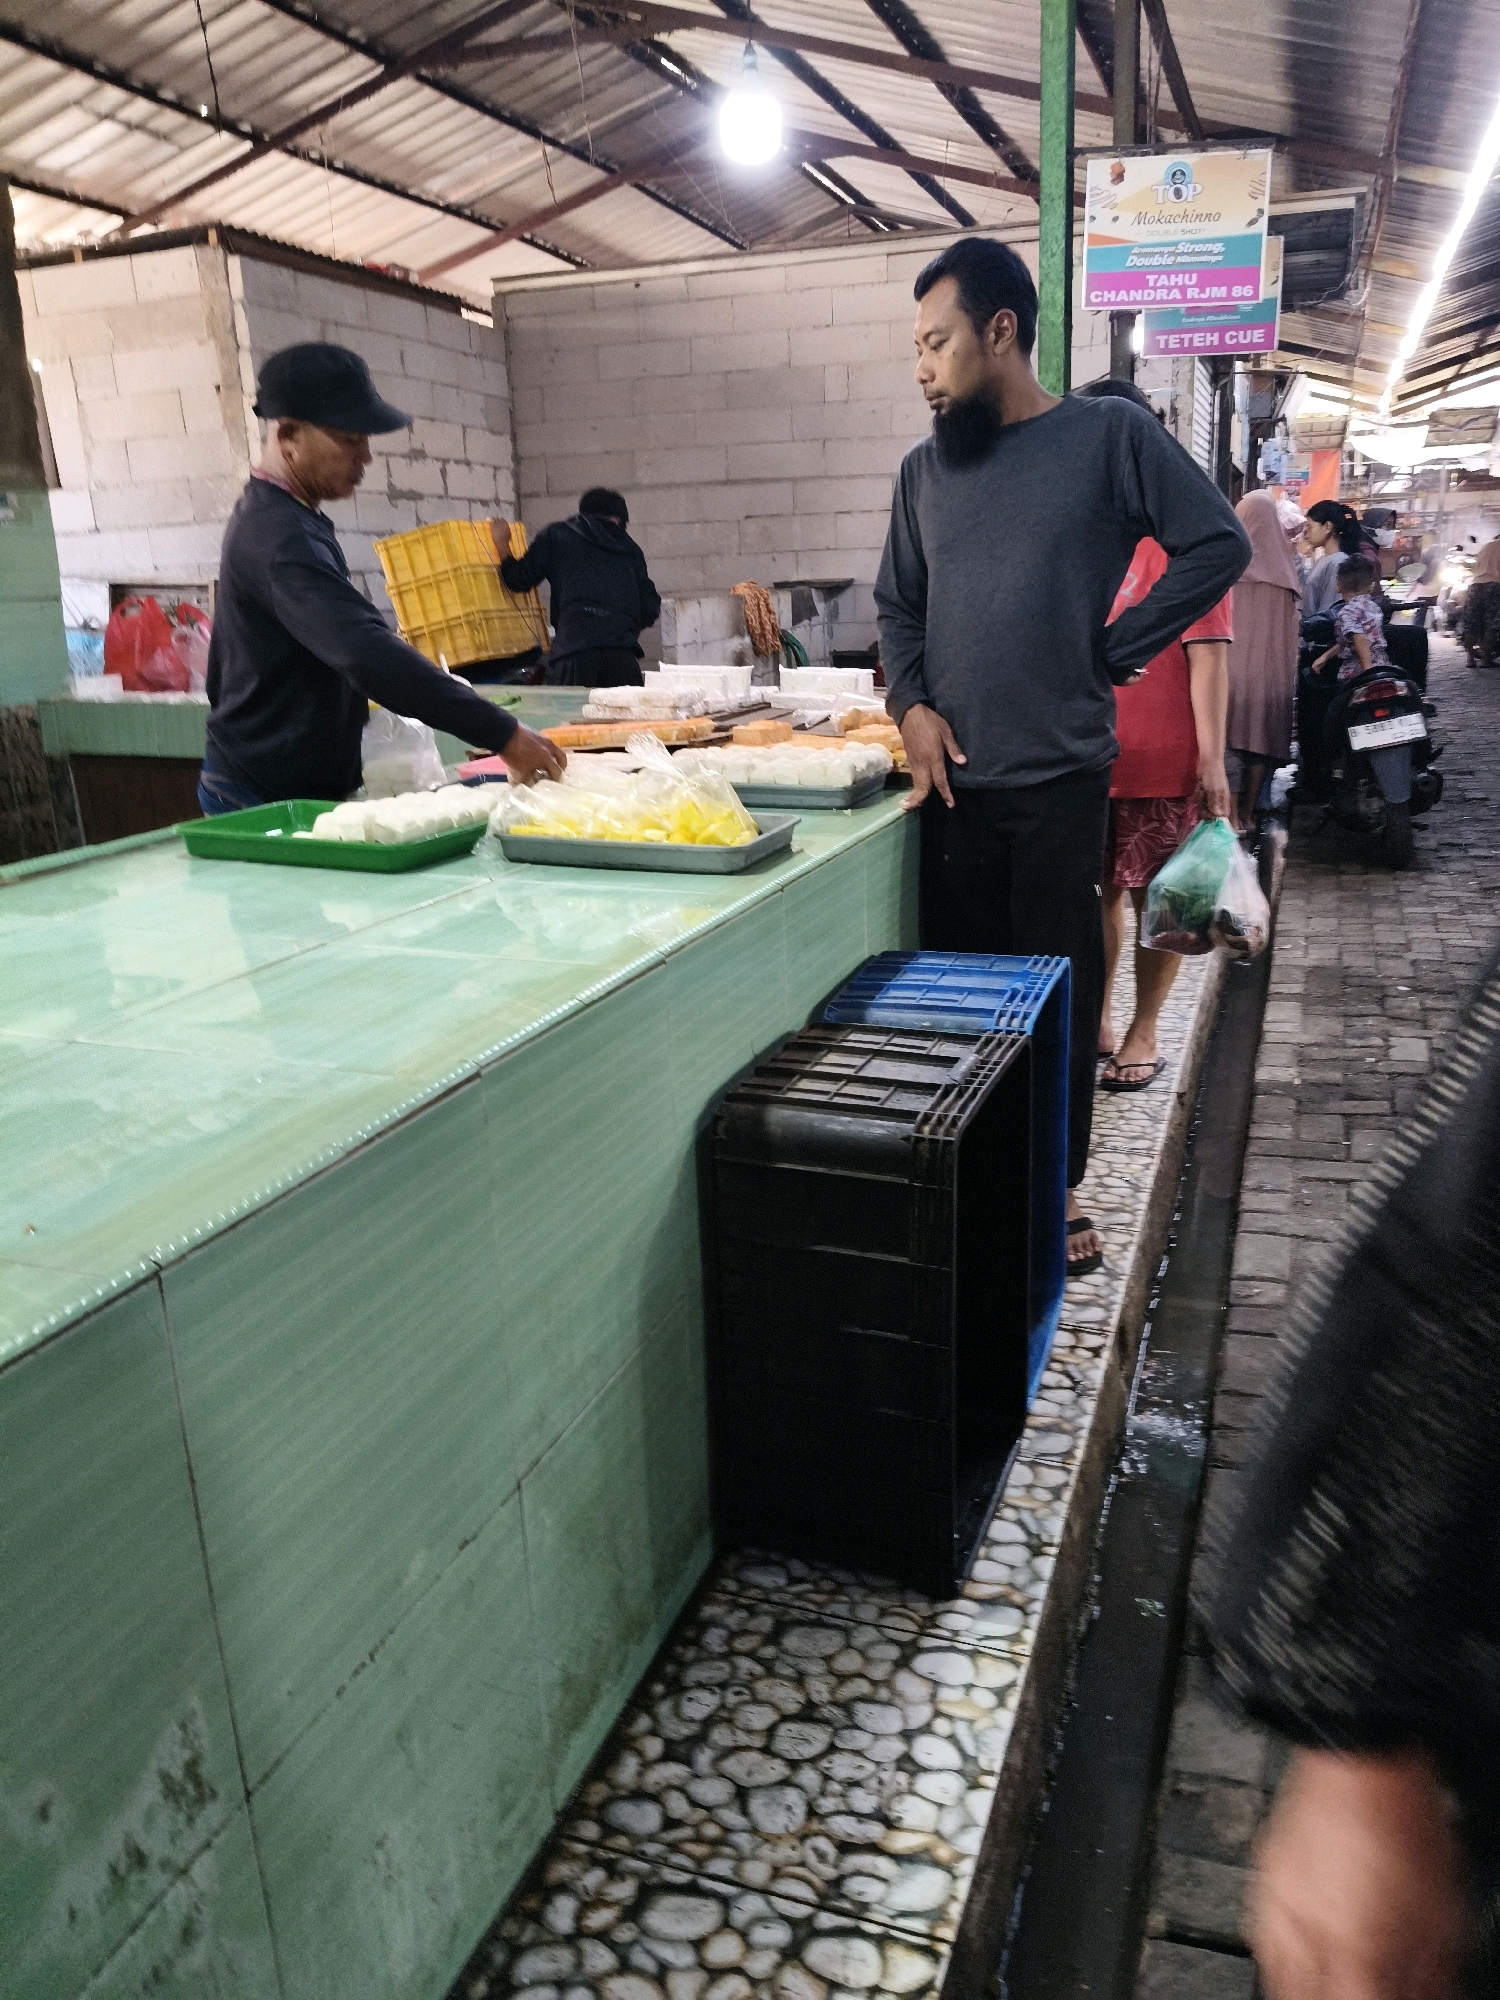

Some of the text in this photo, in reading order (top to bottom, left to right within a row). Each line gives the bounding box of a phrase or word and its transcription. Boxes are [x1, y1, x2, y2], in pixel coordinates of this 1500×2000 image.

[1151, 183, 1203, 204] TOP
[1130, 208, 1222, 226] Mokachinno
[1145, 229, 1179, 237] DOUBLE
[1174, 242, 1226, 254] Strong,
[1125, 253, 1175, 267] Double
[1145, 273, 1198, 287] TAHU
[1089, 285, 1254, 303] CHANDRA RJM 86
[1156, 329, 1266, 349] TETEH CUE
